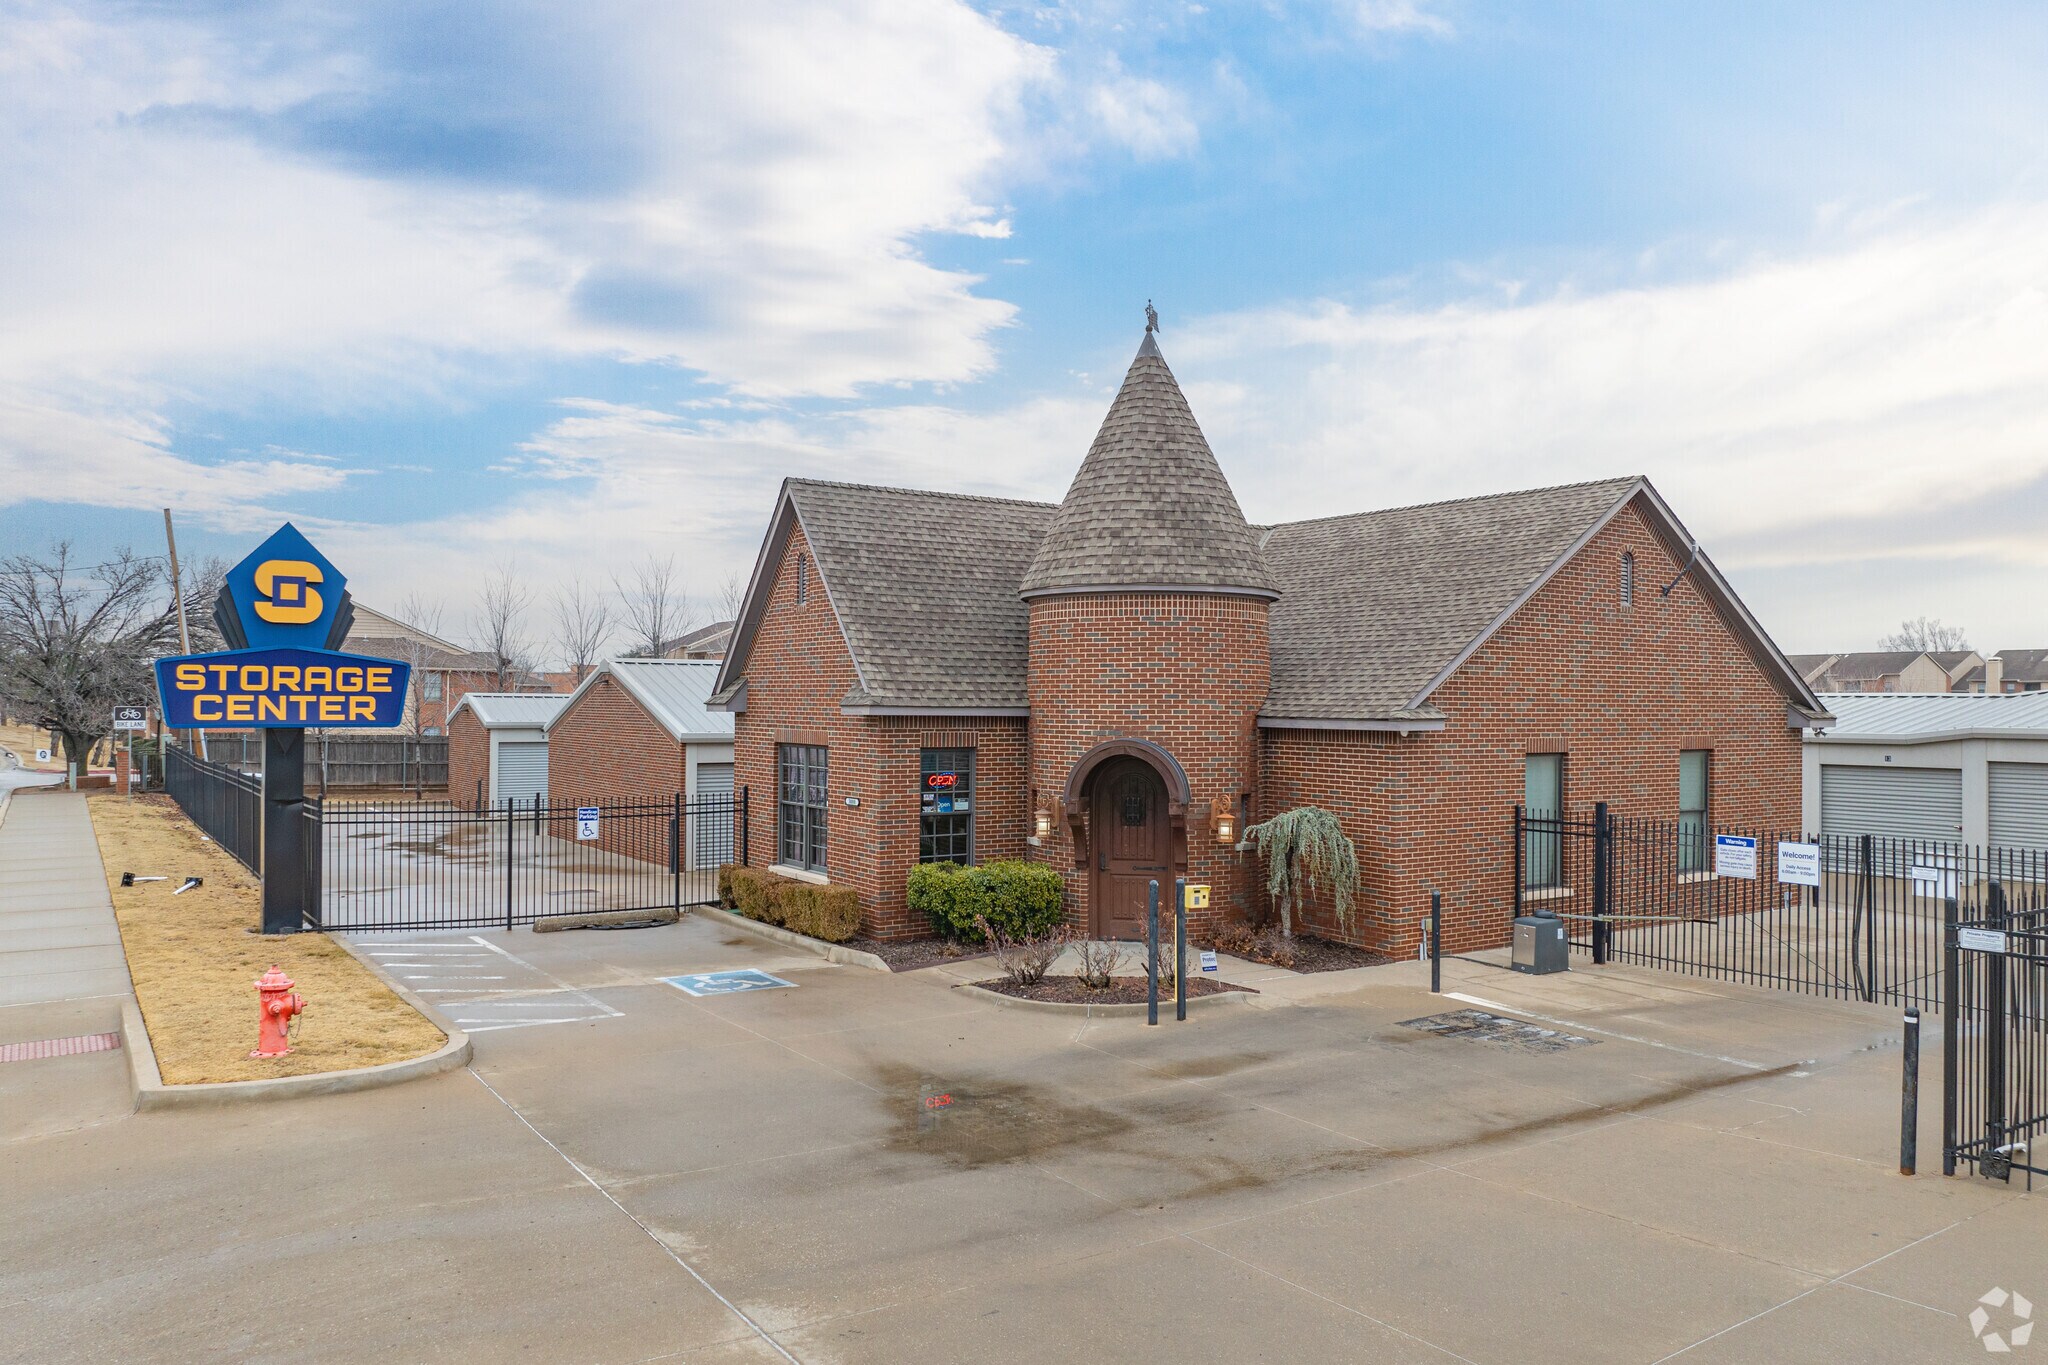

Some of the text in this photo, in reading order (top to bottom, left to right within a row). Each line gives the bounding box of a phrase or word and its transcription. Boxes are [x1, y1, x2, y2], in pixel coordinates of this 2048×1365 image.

[176, 664, 392, 693] STORAGE
[193, 694, 376, 721] CENTER
[928, 775, 957, 786] OPEN
[1725, 838, 1747, 846] Warning
[1782, 851, 1815, 860] Welcome!
